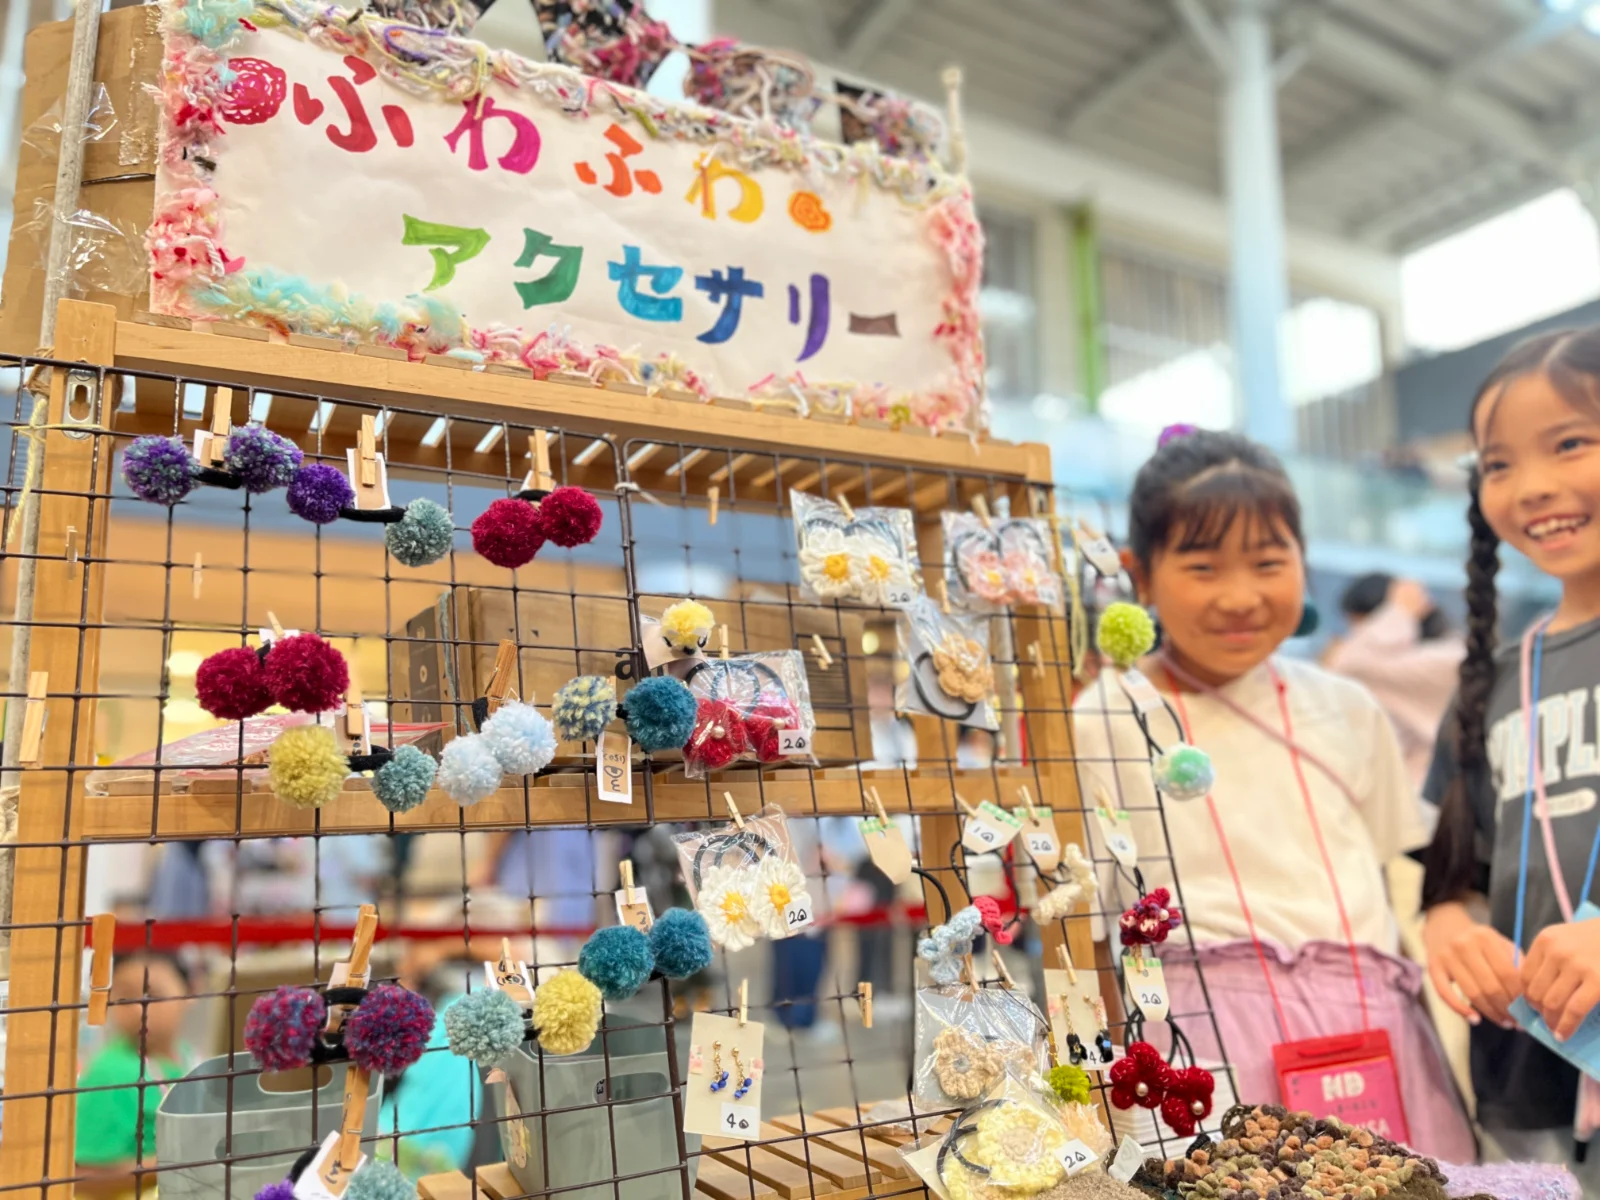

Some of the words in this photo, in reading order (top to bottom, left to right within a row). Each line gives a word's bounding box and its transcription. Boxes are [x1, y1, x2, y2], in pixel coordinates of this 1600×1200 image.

[293, 54, 765, 224] ふわふわ
[401, 212, 901, 362] アクセサリー
